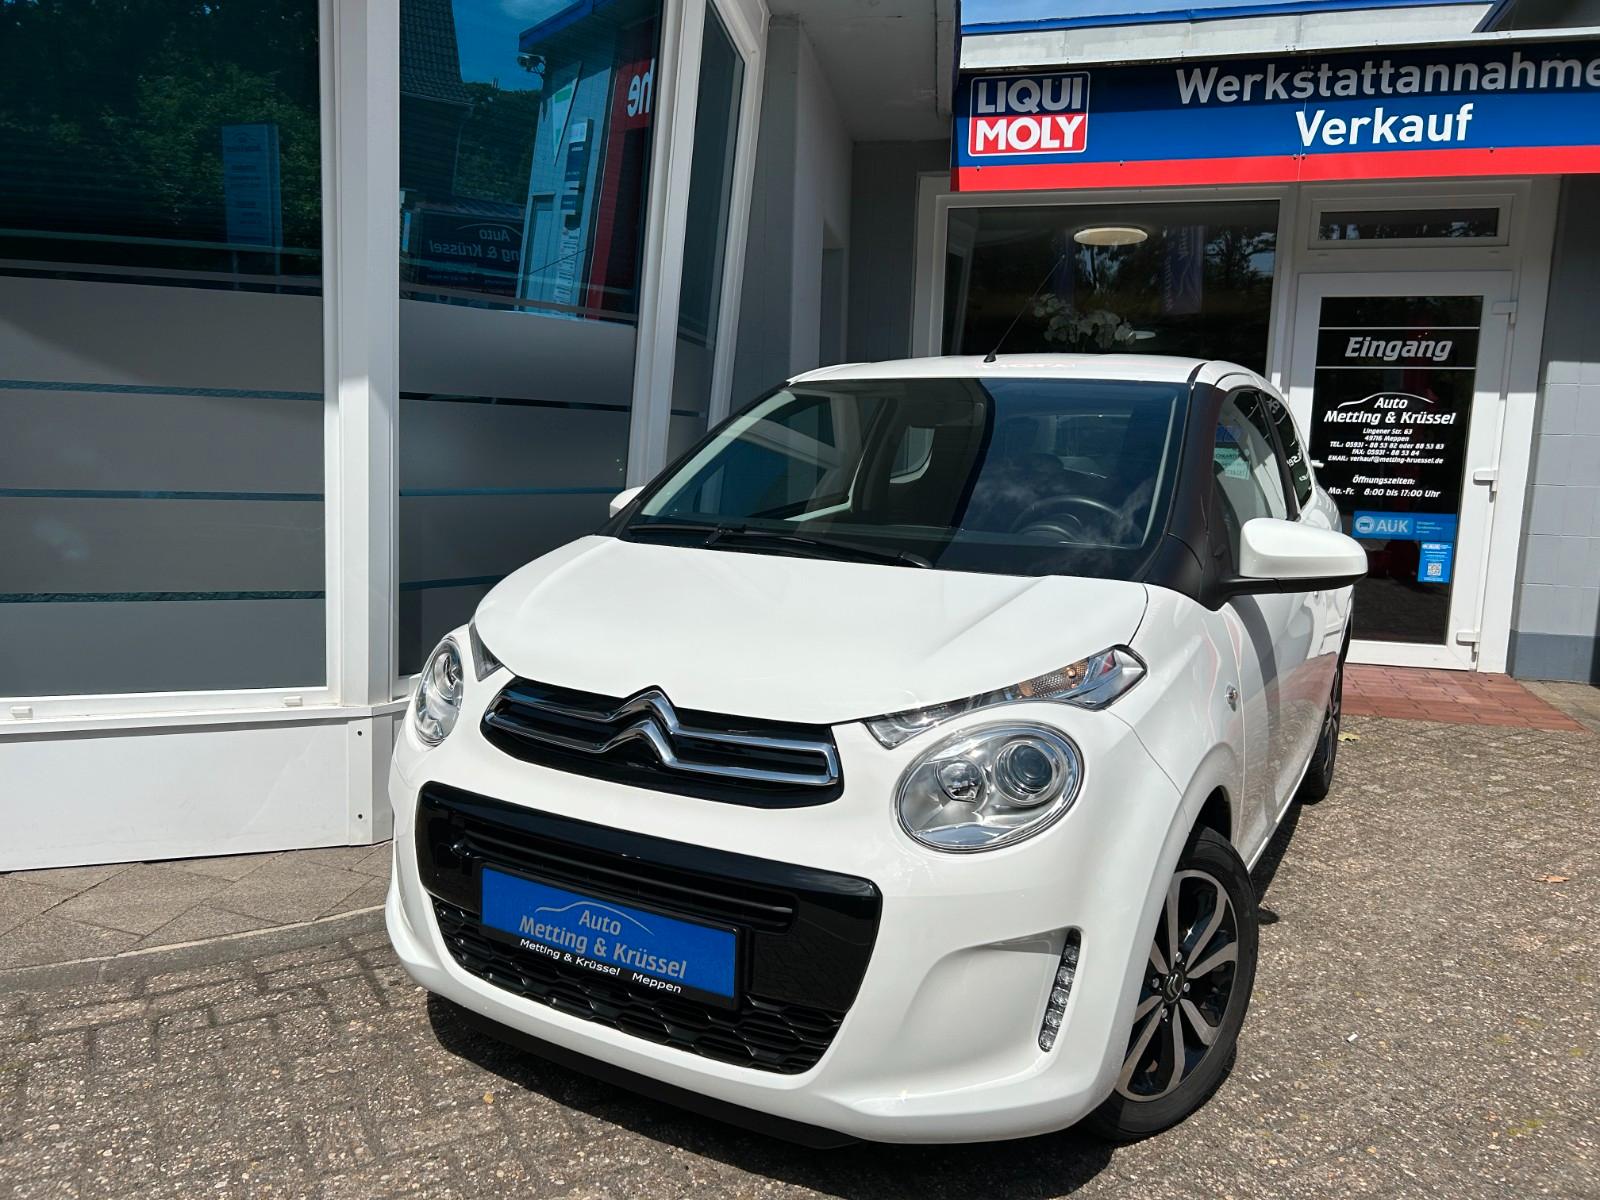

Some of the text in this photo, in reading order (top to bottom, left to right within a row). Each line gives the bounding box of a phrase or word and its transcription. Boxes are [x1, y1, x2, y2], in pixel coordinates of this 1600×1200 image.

[1177, 51, 1600, 105] Werkstattannahme
[977, 77, 1083, 113] LIQUI
[975, 115, 1085, 151] MOLY
[1296, 102, 1474, 147] Verkauf
[1345, 336, 1453, 361] Eingang
[1374, 397, 1408, 409] Auto
[1323, 410, 1457, 425] Metting & Krüssel
[1362, 427, 1390, 435] Lingener
[1327, 454, 1349, 462] EMAIL:
[1327, 486, 1441, 498] Mo.-Fr. 8:00 bis 17:00 Uhr
[1352, 474, 1416, 486] Öffnungszeiten:
[1375, 519, 1409, 533] AUK
[579, 909, 621, 936] Auto
[519, 915, 687, 979] Metting & Krüssel
[519, 938, 682, 994] Metting & Krüssel Meppen
